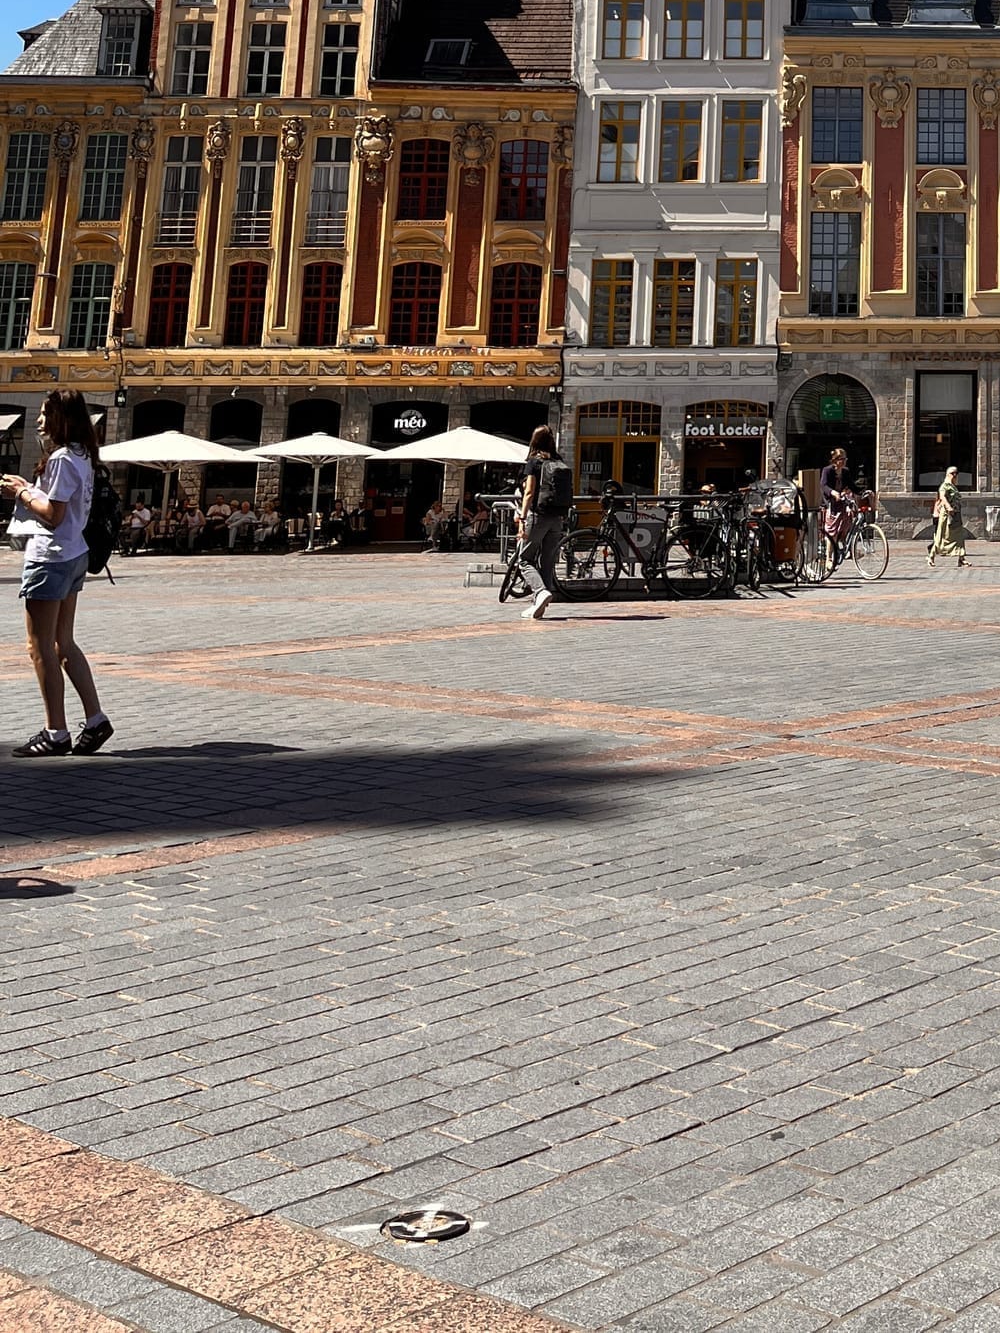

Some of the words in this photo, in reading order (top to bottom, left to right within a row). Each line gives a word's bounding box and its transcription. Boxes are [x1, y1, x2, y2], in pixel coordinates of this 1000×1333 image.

[394, 416, 427, 428] méo
[685, 423, 715, 436] Foot
[719, 423, 765, 436] Locker
